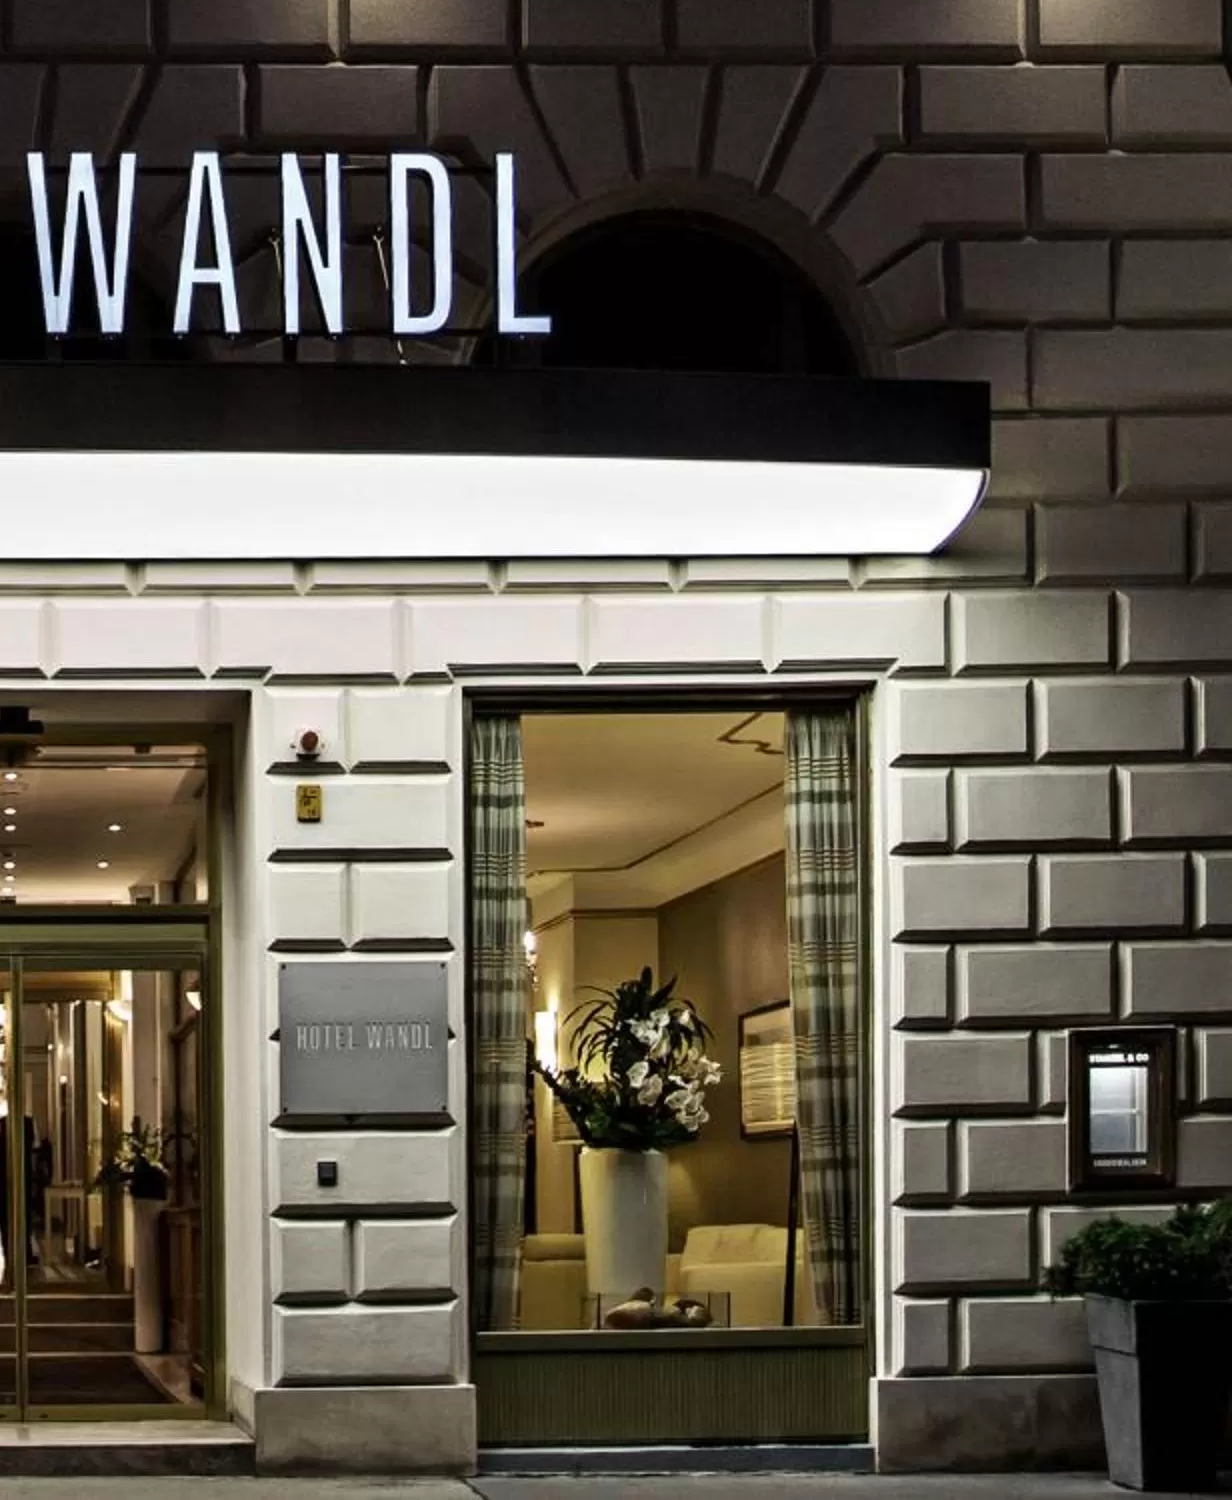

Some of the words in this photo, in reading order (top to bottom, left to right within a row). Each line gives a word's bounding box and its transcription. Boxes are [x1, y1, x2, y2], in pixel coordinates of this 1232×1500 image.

[26, 151, 552, 335] WANDL
[296, 1022, 359, 1050] HOTEL
[365, 1021, 433, 1050] WANDL
